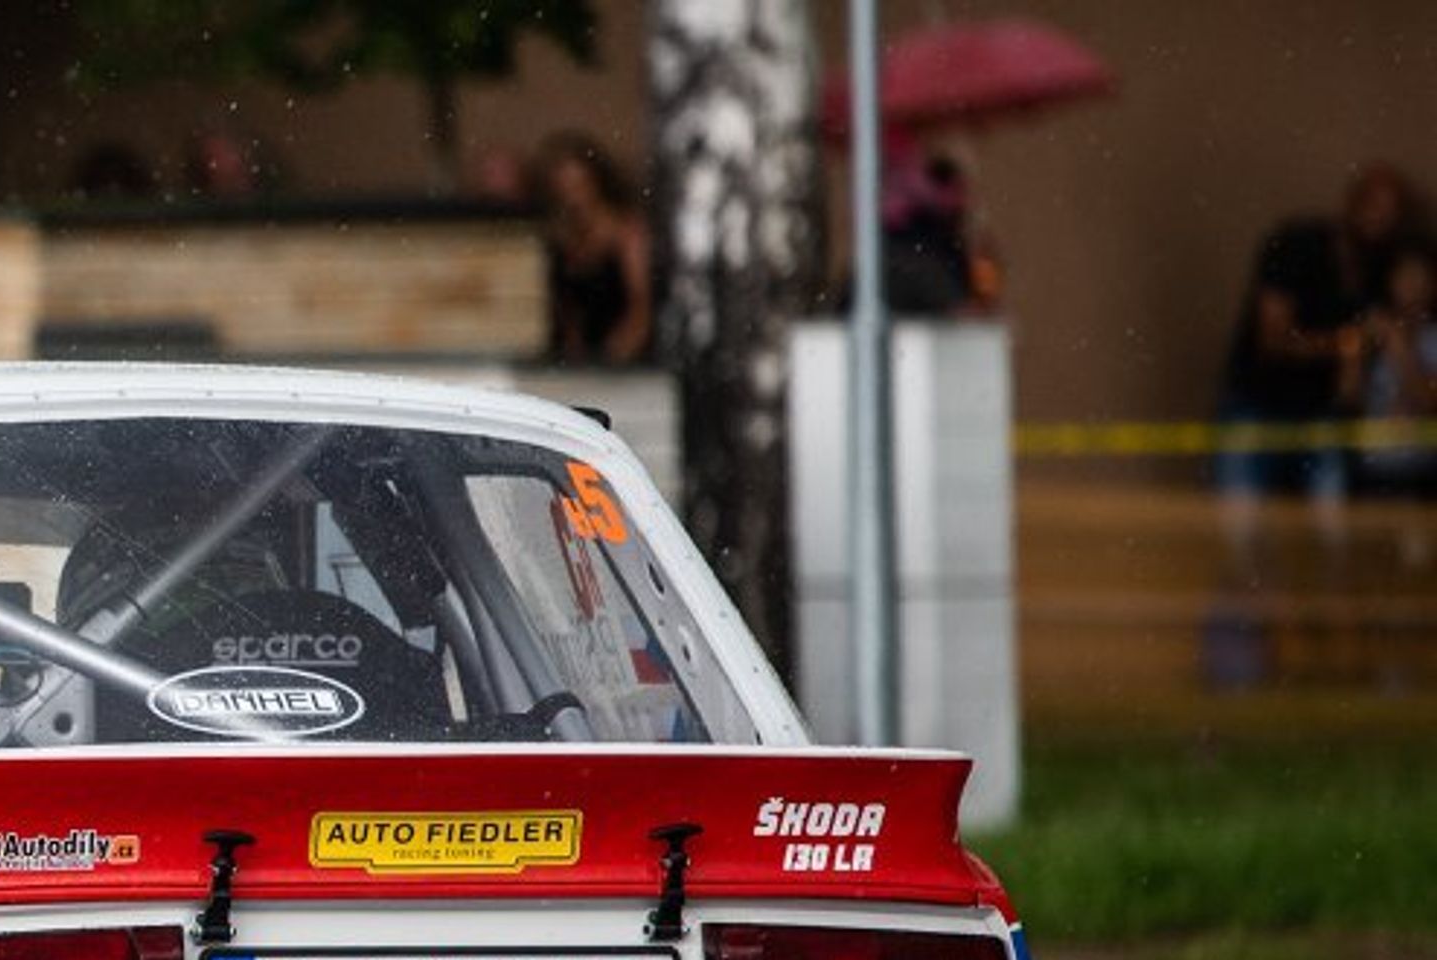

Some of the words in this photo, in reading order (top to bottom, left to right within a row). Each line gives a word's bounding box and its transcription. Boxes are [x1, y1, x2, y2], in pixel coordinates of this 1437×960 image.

[213, 631, 362, 668] sparco
[327, 822, 415, 845] AUTO
[427, 820, 564, 843] FIEDLER
[753, 797, 887, 838] ŠKODA
[782, 844, 830, 872] 130
[833, 844, 876, 872] LR
